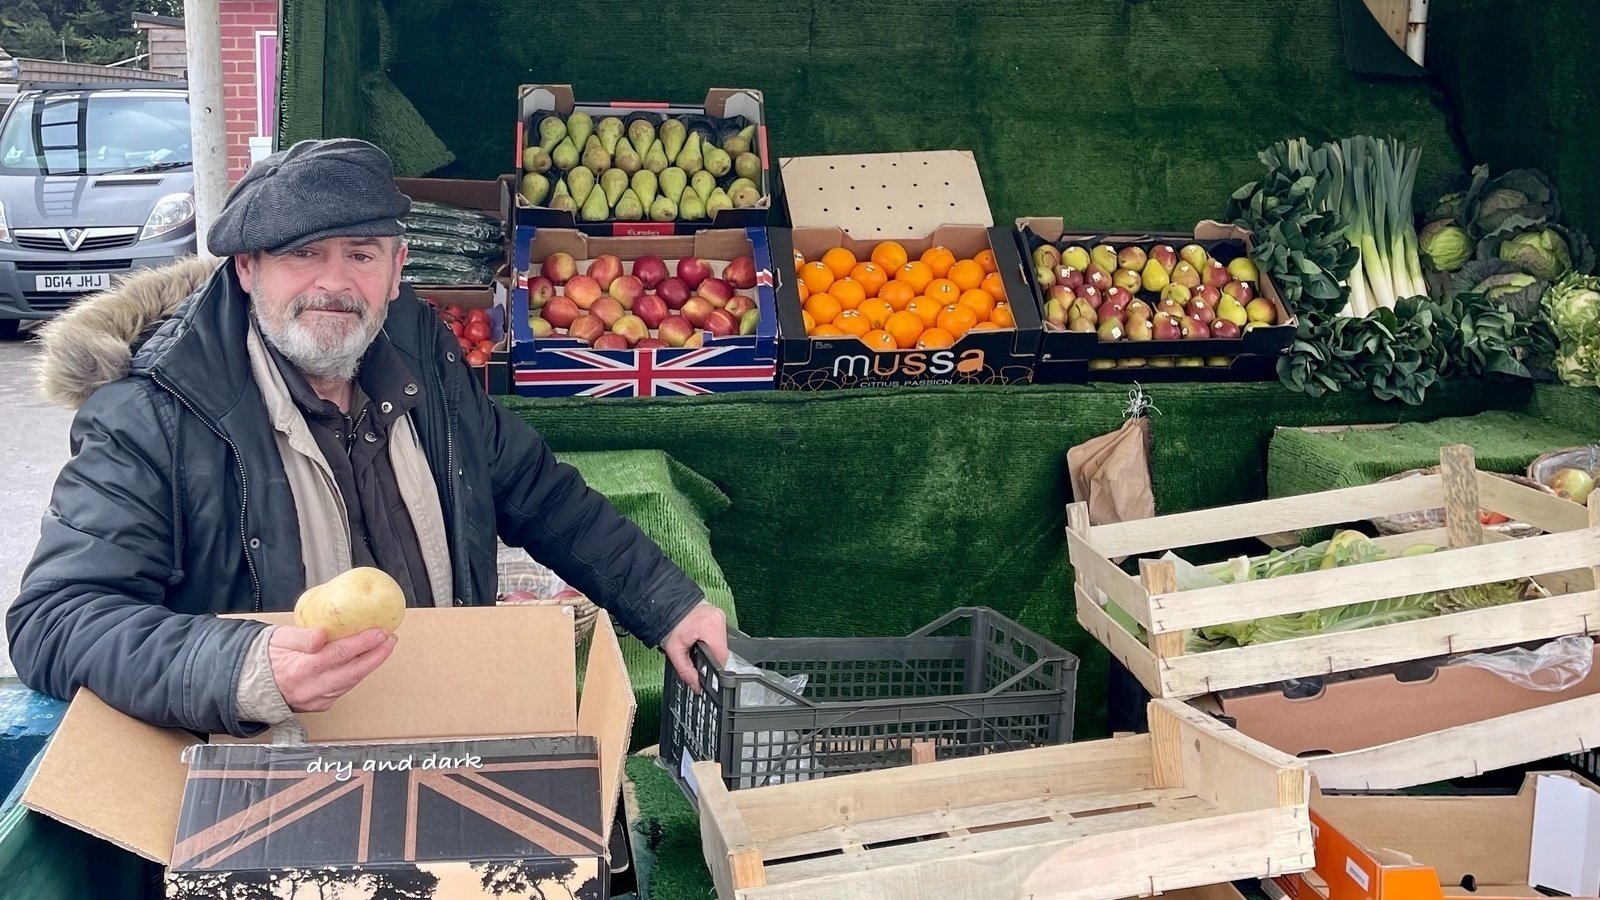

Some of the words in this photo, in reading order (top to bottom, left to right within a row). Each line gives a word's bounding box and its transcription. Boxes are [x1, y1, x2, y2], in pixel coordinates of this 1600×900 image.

[44, 275, 72, 288] DG14
[77, 275, 102, 287] JHJ
[833, 349, 985, 378] mussa
[860, 380, 900, 388] CITRUS
[904, 379, 953, 387] PASSION
[307, 756, 353, 782] dry
[362, 754, 413, 773] and
[422, 753, 484, 771] dark
